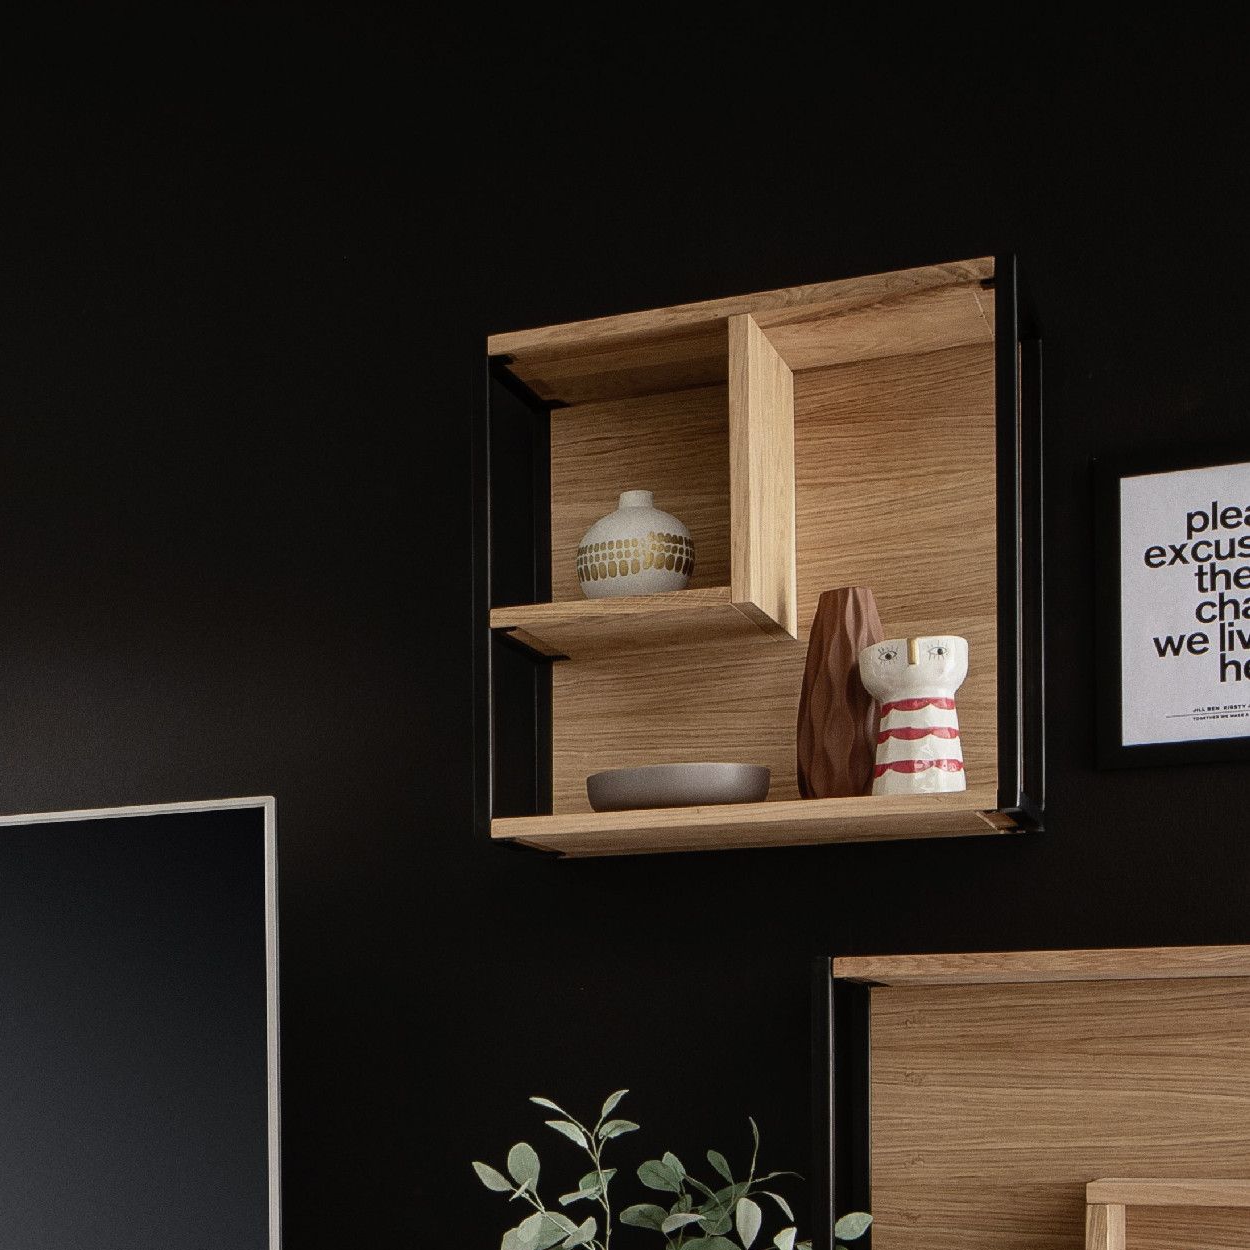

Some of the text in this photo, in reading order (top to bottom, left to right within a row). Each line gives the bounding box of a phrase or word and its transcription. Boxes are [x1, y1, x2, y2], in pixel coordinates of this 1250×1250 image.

[1186, 501, 1250, 540] ple
[1194, 562, 1250, 593] the
[1153, 631, 1210, 658] we
[1220, 652, 1250, 682] h
